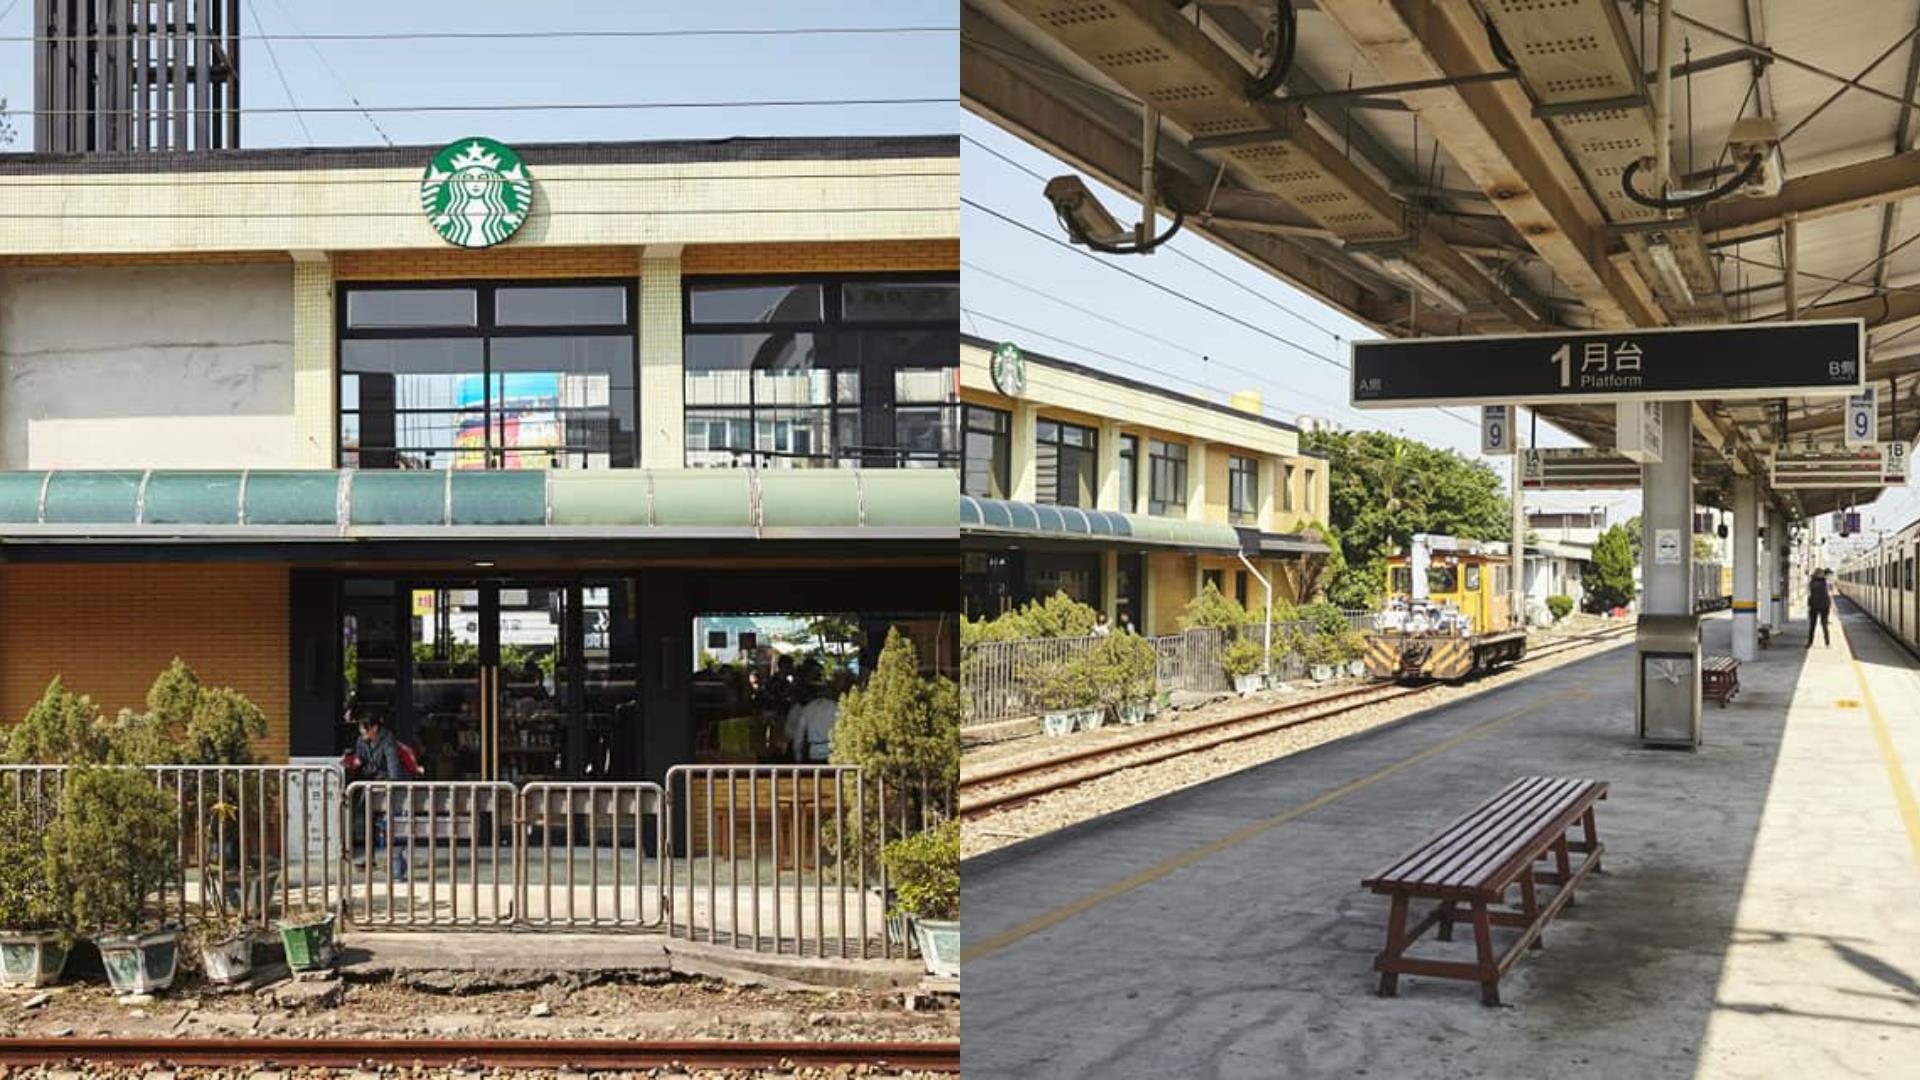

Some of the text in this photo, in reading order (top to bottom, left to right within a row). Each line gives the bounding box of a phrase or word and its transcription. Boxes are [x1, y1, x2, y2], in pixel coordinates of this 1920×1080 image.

[1550, 340, 1643, 387] 1 月台
[1581, 374, 1643, 387] Platform
[1490, 423, 1502, 447] 9
[1856, 412, 1868, 437] 9
[1887, 442, 1904, 457] 1B
